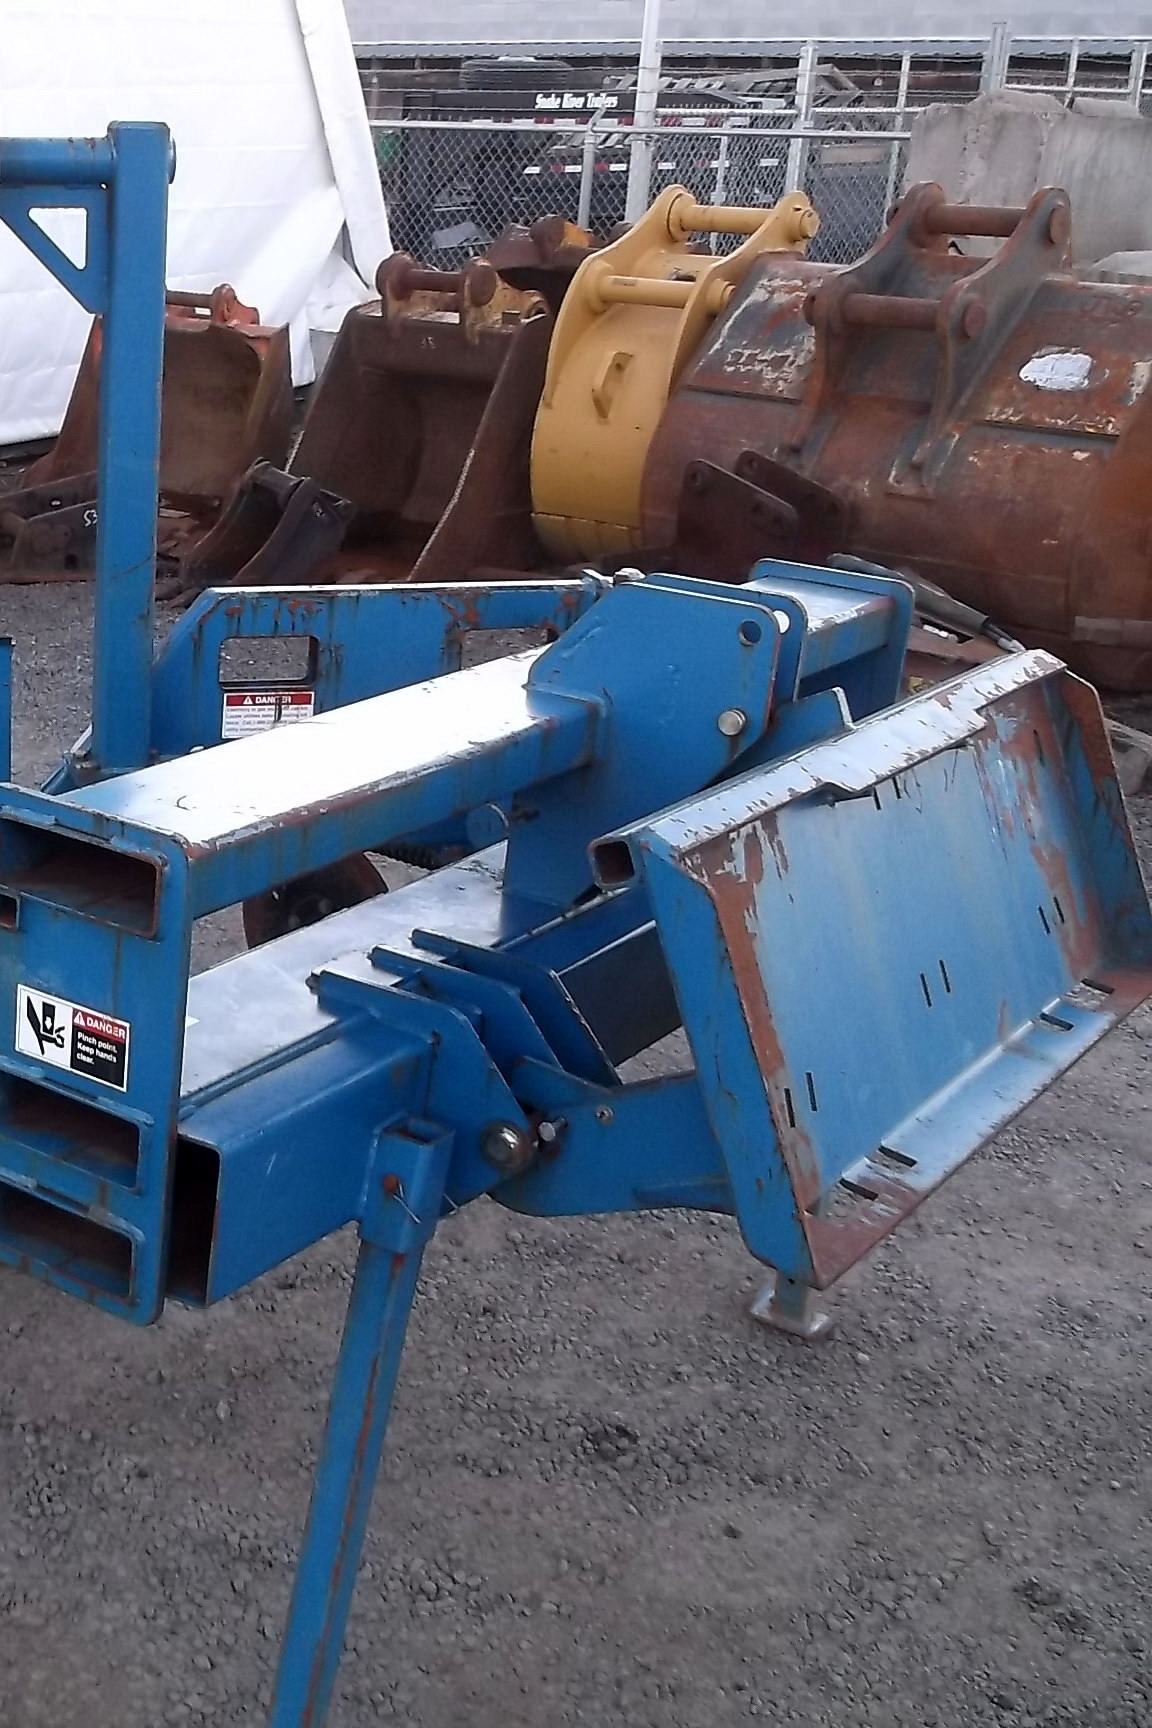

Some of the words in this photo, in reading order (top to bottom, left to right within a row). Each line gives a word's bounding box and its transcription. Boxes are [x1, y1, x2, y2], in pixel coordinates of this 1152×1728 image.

[86, 1016, 126, 1040] DANGER
[77, 1031, 97, 1046] Pinch
[98, 1040, 118, 1054] point.
[77, 1042, 95, 1055] Keep
[95, 1048, 117, 1063] hands
[76, 1053, 95, 1065] clear.
